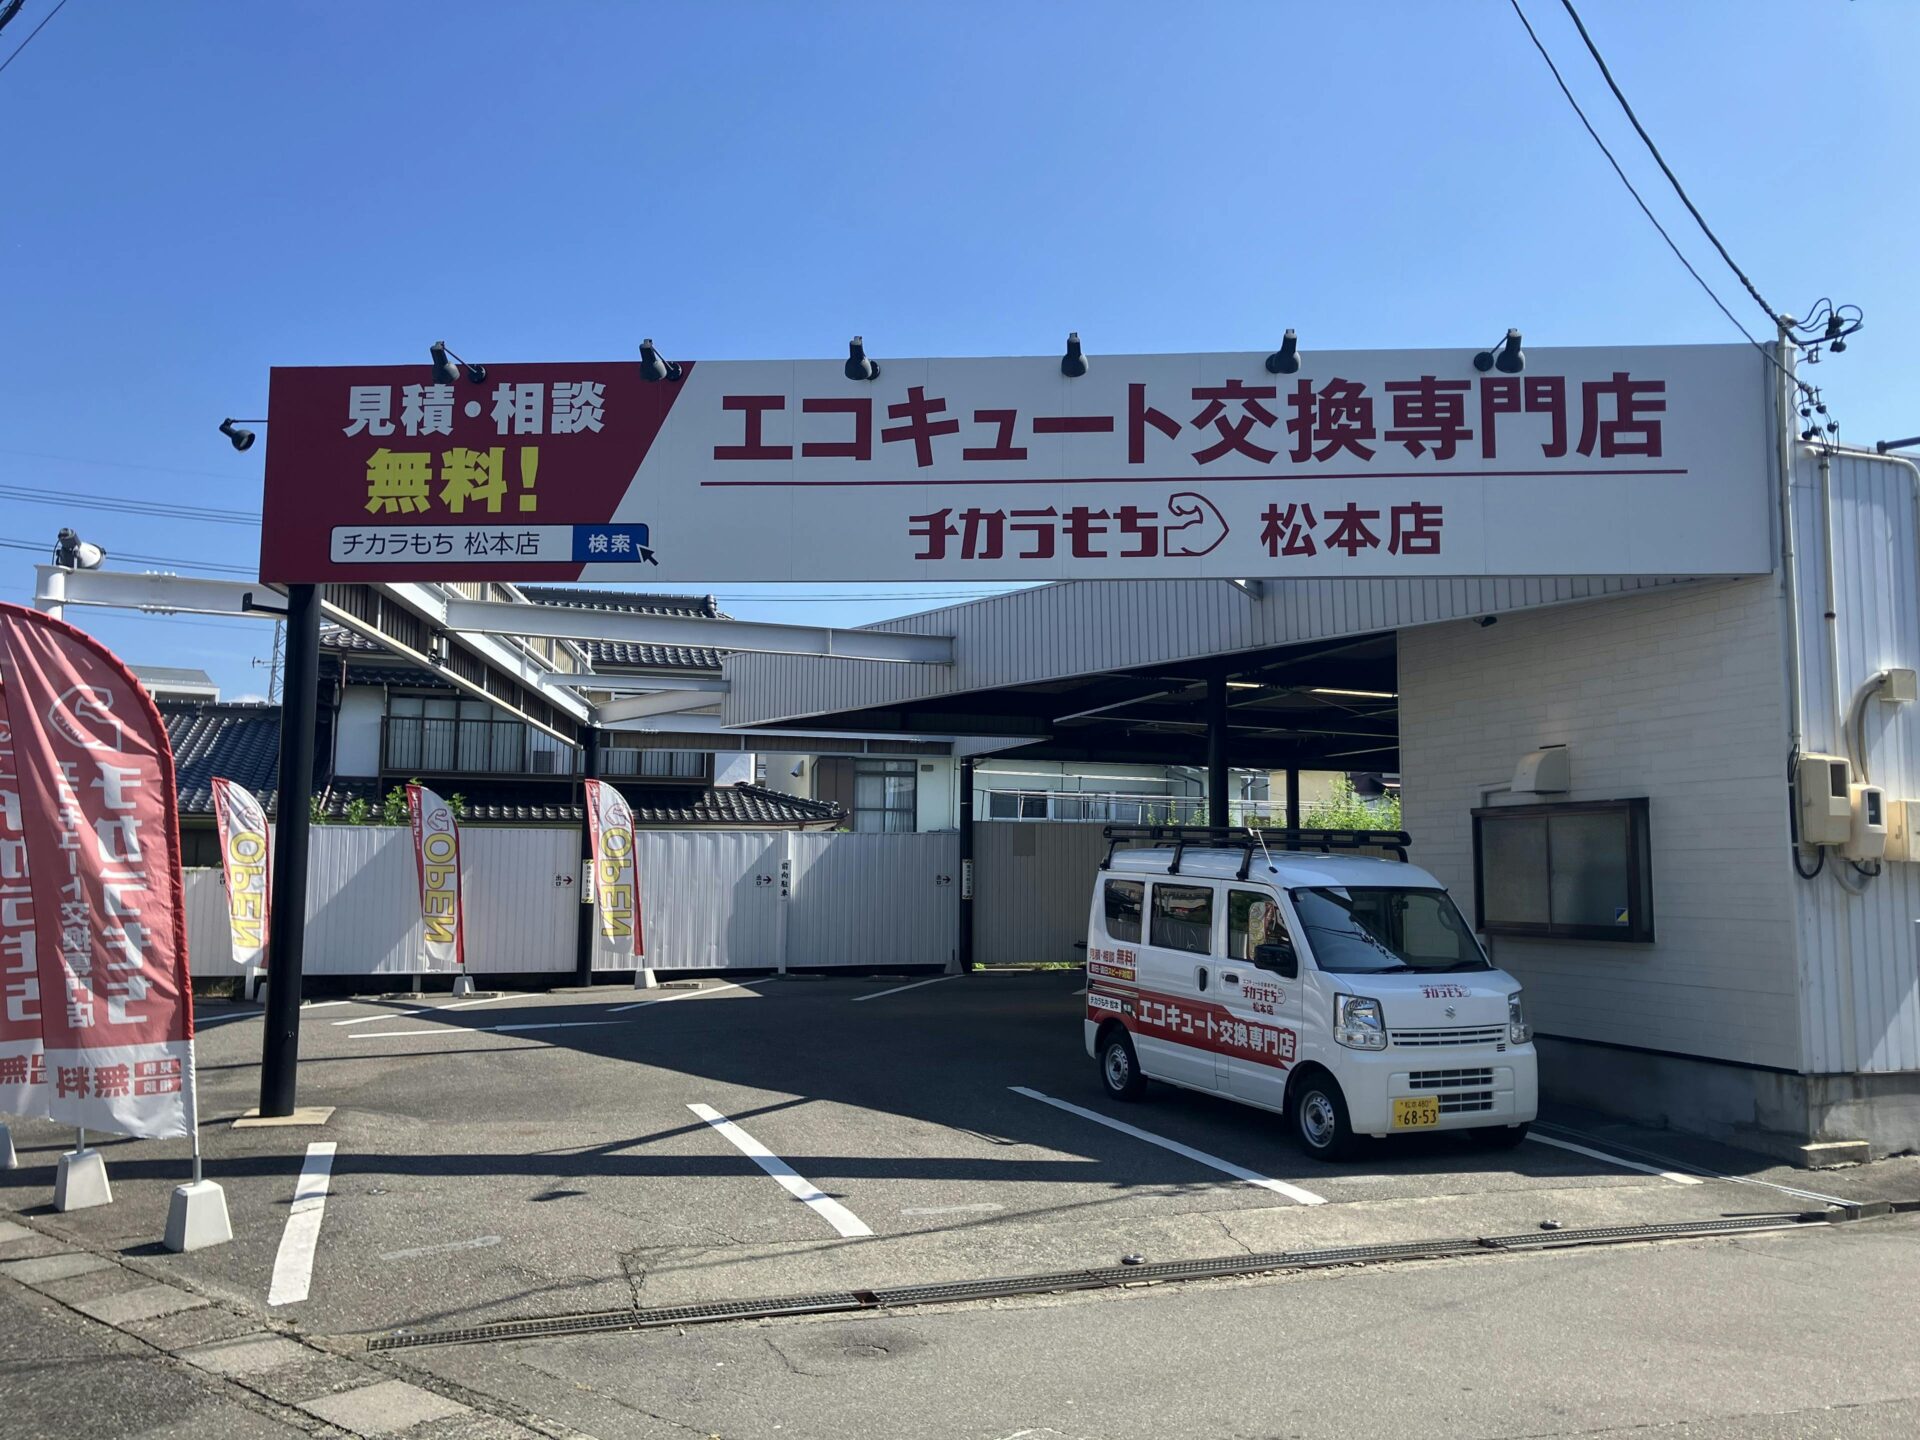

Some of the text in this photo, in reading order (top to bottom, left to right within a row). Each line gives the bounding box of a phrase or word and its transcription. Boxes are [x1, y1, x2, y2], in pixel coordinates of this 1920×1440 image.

[342, 381, 607, 438] 見積・相談
[714, 372, 1666, 467] エコキュート交換専門店
[364, 445, 540, 514] 無料!
[342, 531, 540, 556] チカラもち 松本店
[588, 533, 631, 554] 検索
[909, 501, 1443, 560] チカラもち 松本店
[1139, 1000, 1294, 1059] エコキュート交換専門店
[1404, 1110, 1437, 1125] 68-53
